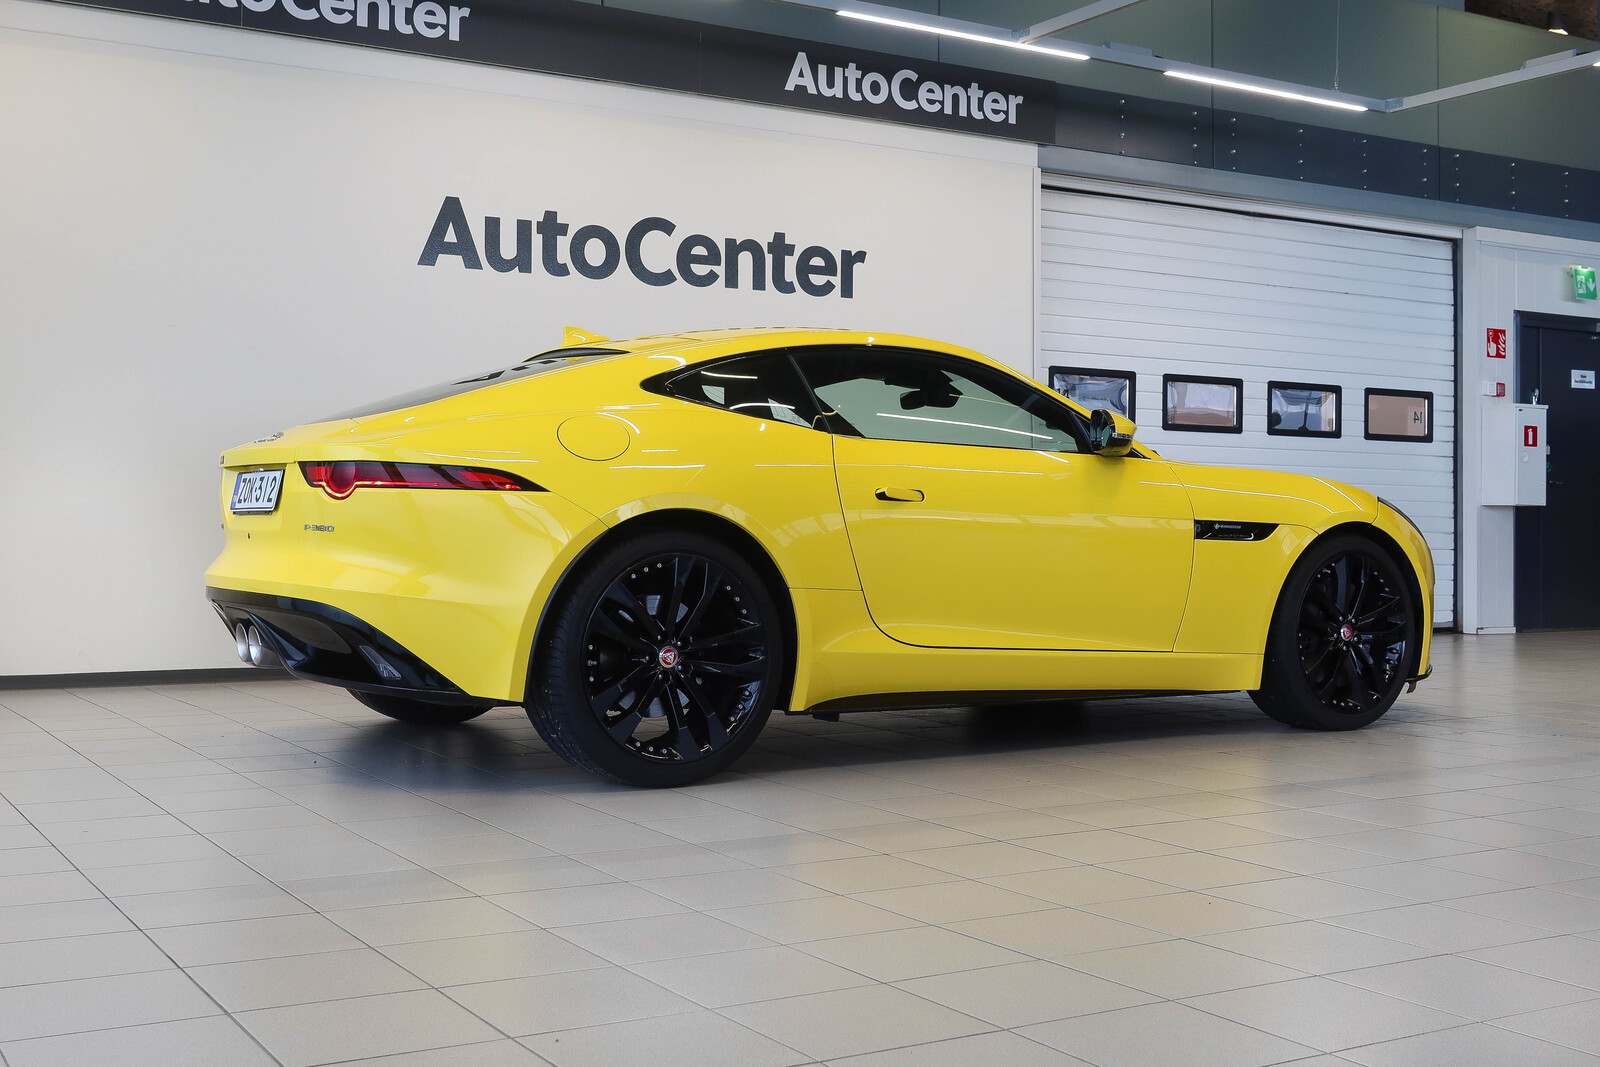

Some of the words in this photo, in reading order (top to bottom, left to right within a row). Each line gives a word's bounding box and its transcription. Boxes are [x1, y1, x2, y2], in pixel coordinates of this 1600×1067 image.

[184, 0, 470, 41] enter
[784, 51, 1024, 125] AutoCenter
[417, 195, 867, 299] AutoCenter
